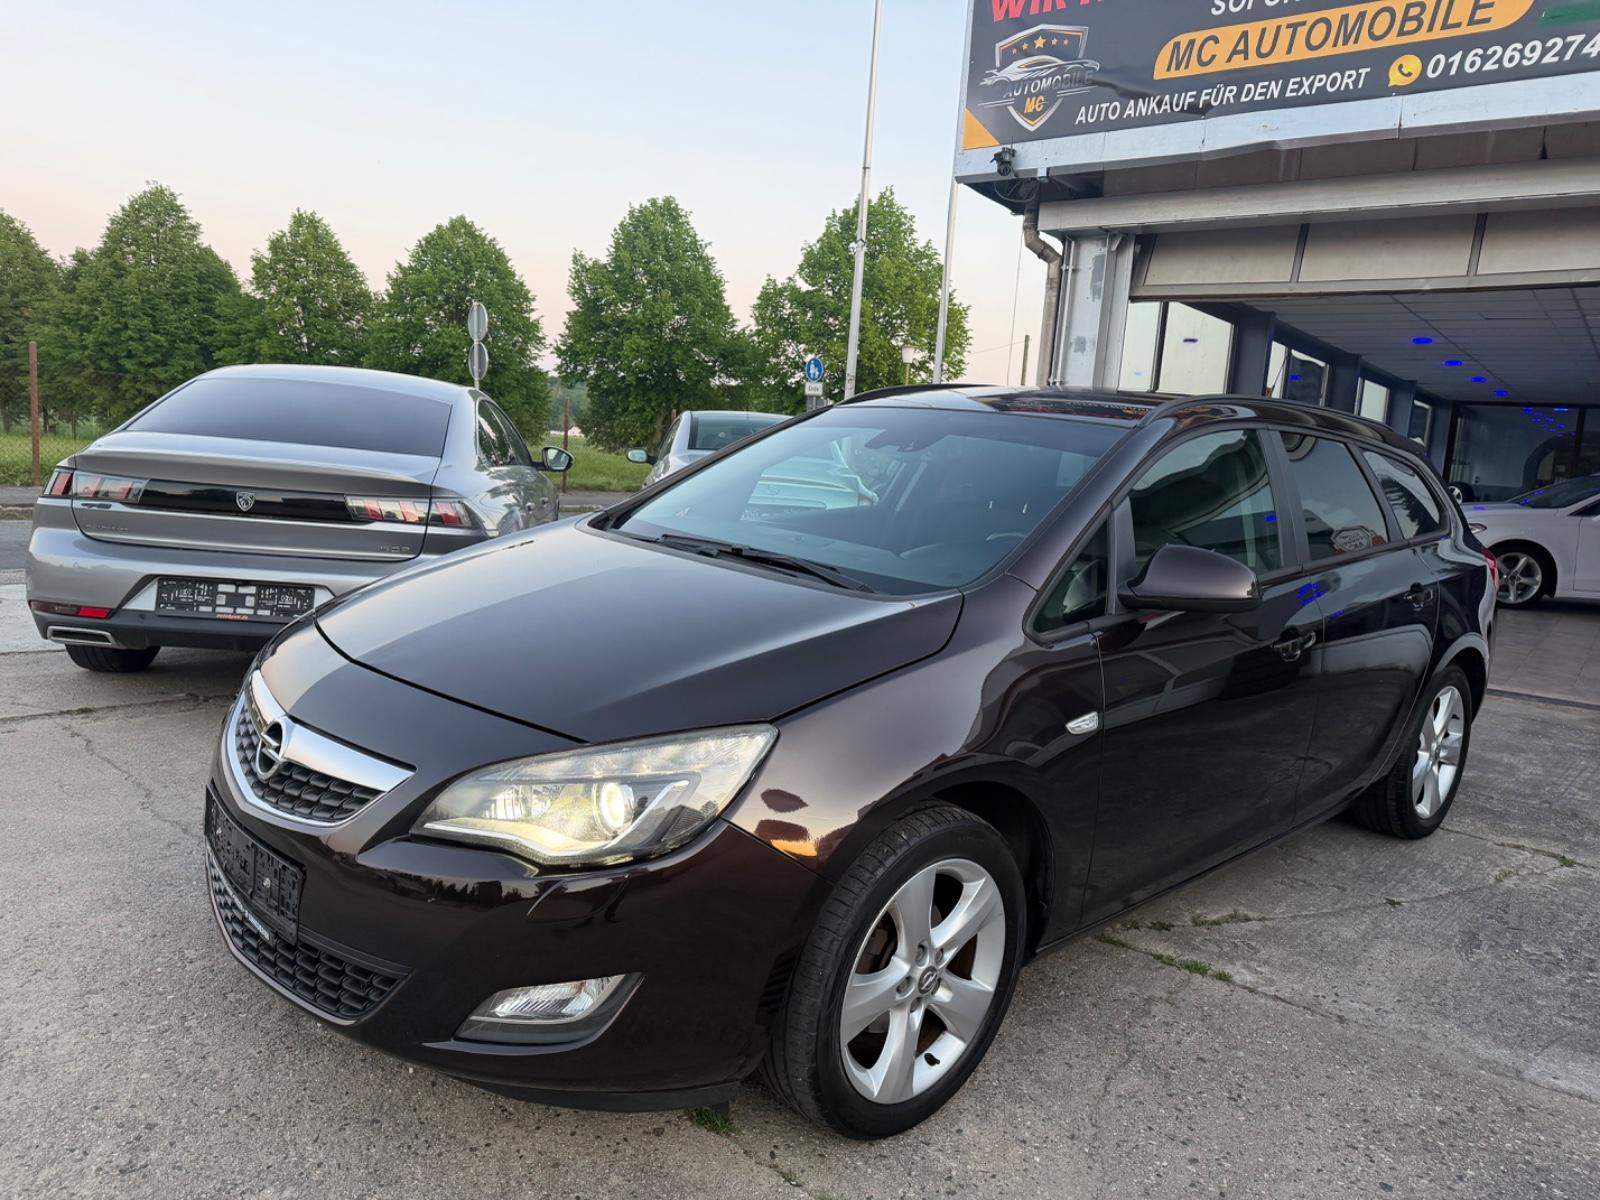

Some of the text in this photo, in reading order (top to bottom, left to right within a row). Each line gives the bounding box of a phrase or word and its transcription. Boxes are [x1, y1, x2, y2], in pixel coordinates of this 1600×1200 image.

[1166, 0, 1495, 72] MC AUTOMOBILE
[1426, 32, 1600, 79] 016269274
[1003, 71, 1093, 98] AUTOMOBILE
[1024, 95, 1045, 114] MC
[1075, 67, 1370, 125] AUTO ANKAUF FÜR DEN EXPORT
